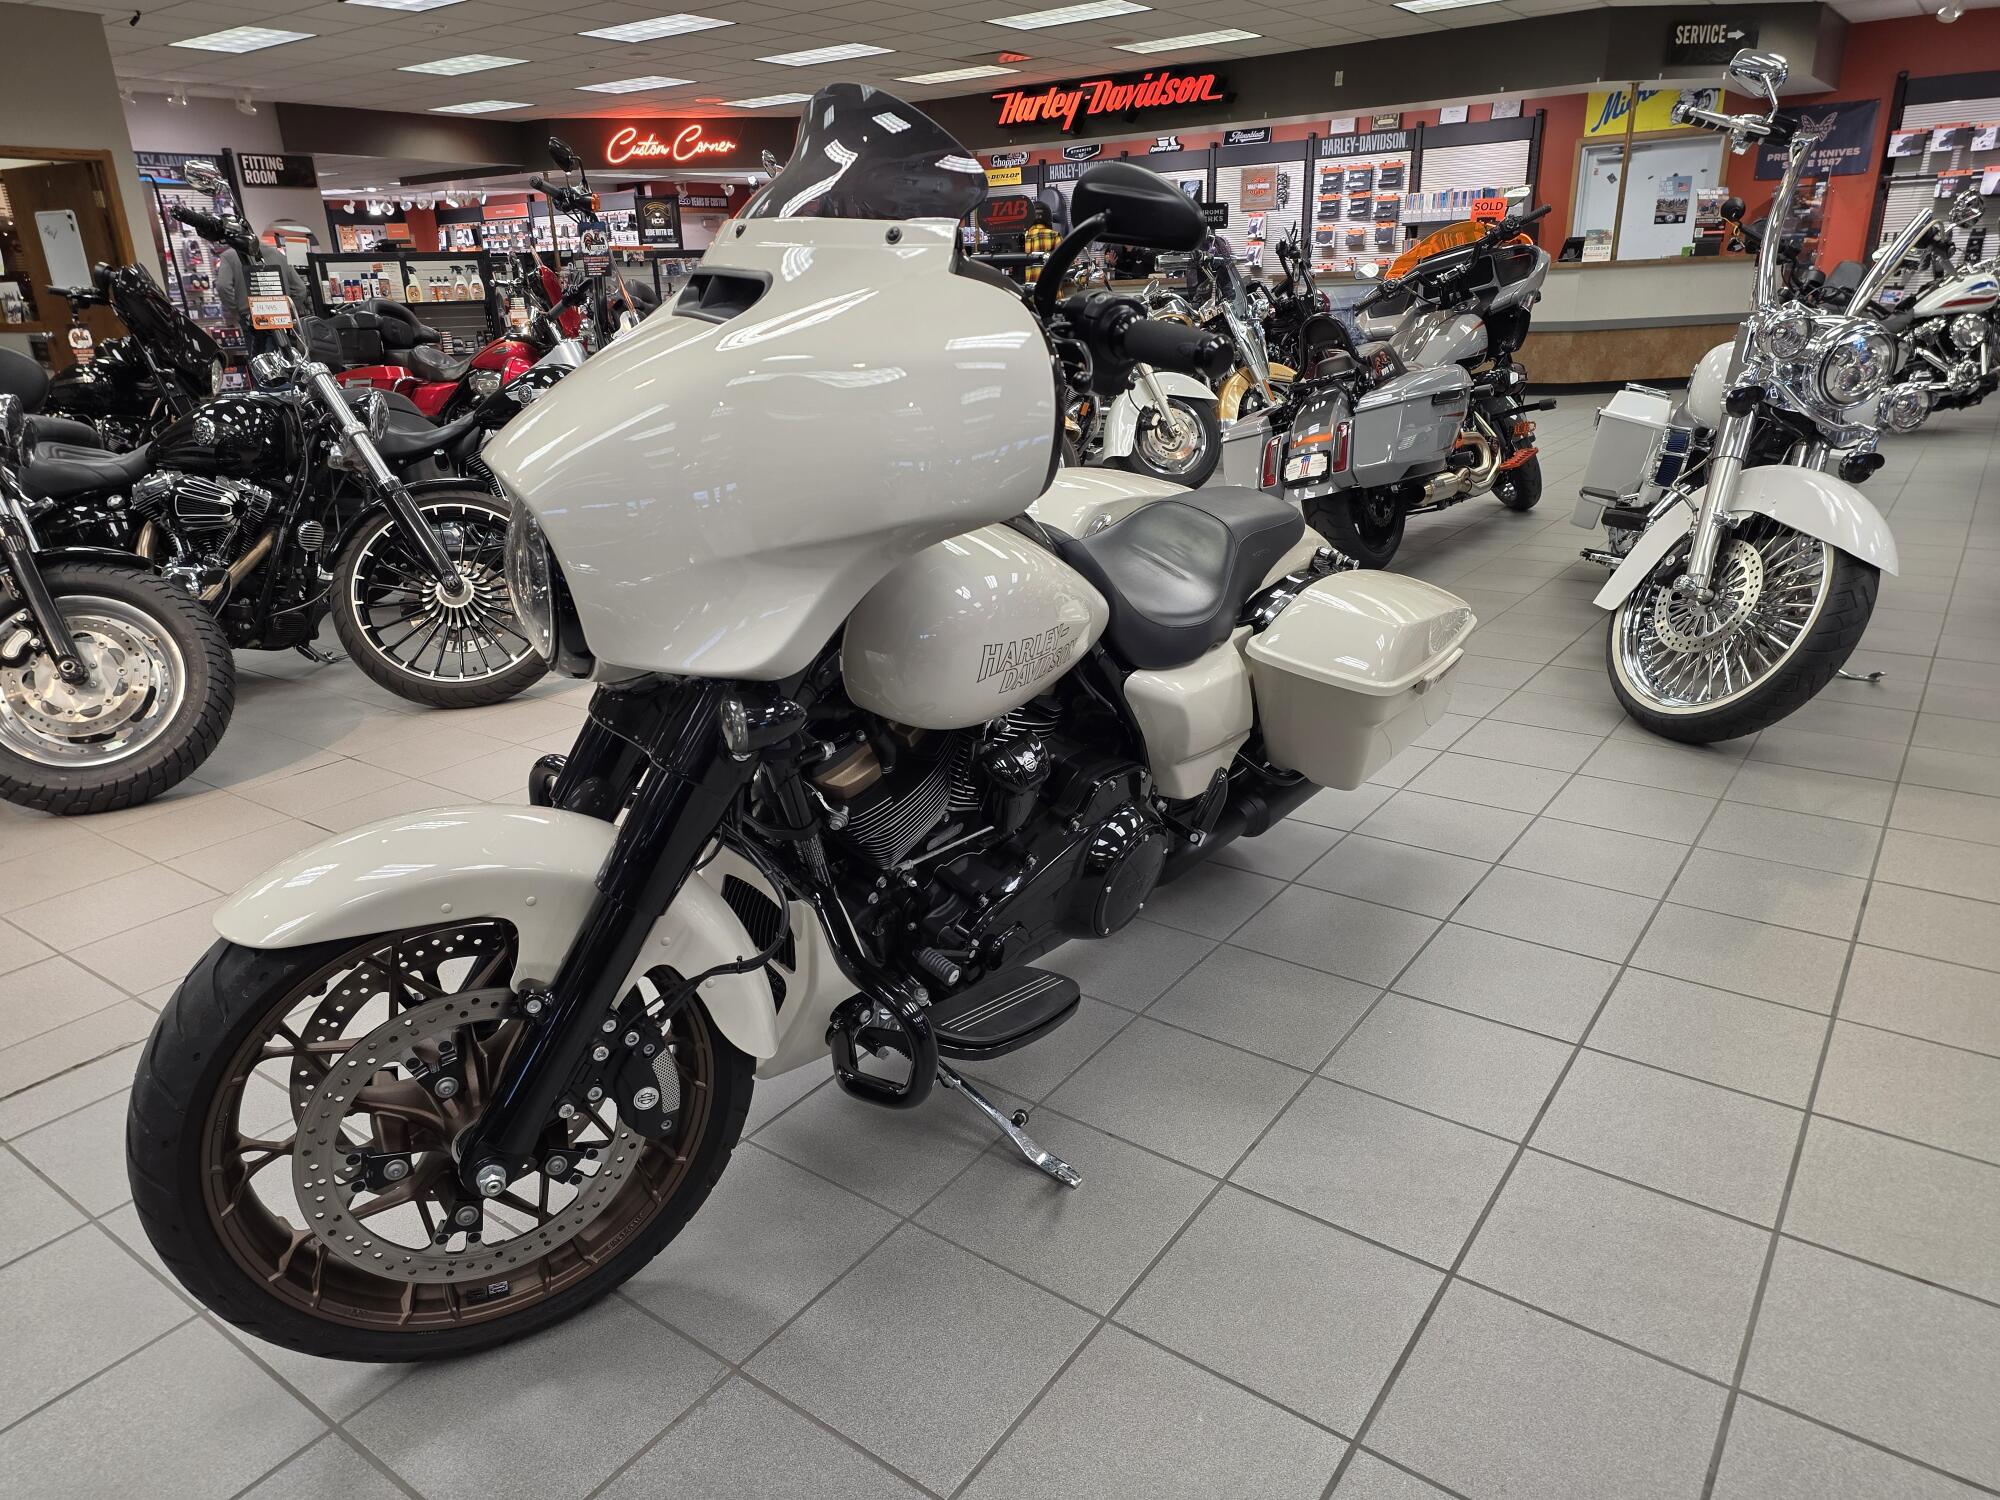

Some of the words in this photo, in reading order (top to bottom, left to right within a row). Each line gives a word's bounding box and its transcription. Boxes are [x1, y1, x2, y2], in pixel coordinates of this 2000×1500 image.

[1675, 24, 1727, 45] SERVICE
[992, 72, 1223, 131] Harley-Davidson
[607, 127, 670, 164] Custom
[673, 124, 736, 161] Corner
[1321, 131, 1408, 156] HARLEY-DAVIDSON
[1819, 146, 1861, 159] KNIVES
[241, 155, 285, 171] FITTING
[1818, 157, 1842, 167] 1987
[244, 169, 278, 185] ROOM
[990, 172, 1020, 180] DUNLOP
[991, 200, 1028, 217] TAB
[1473, 201, 1504, 211] SOLD
[976, 623, 1070, 683] HARLEY-
